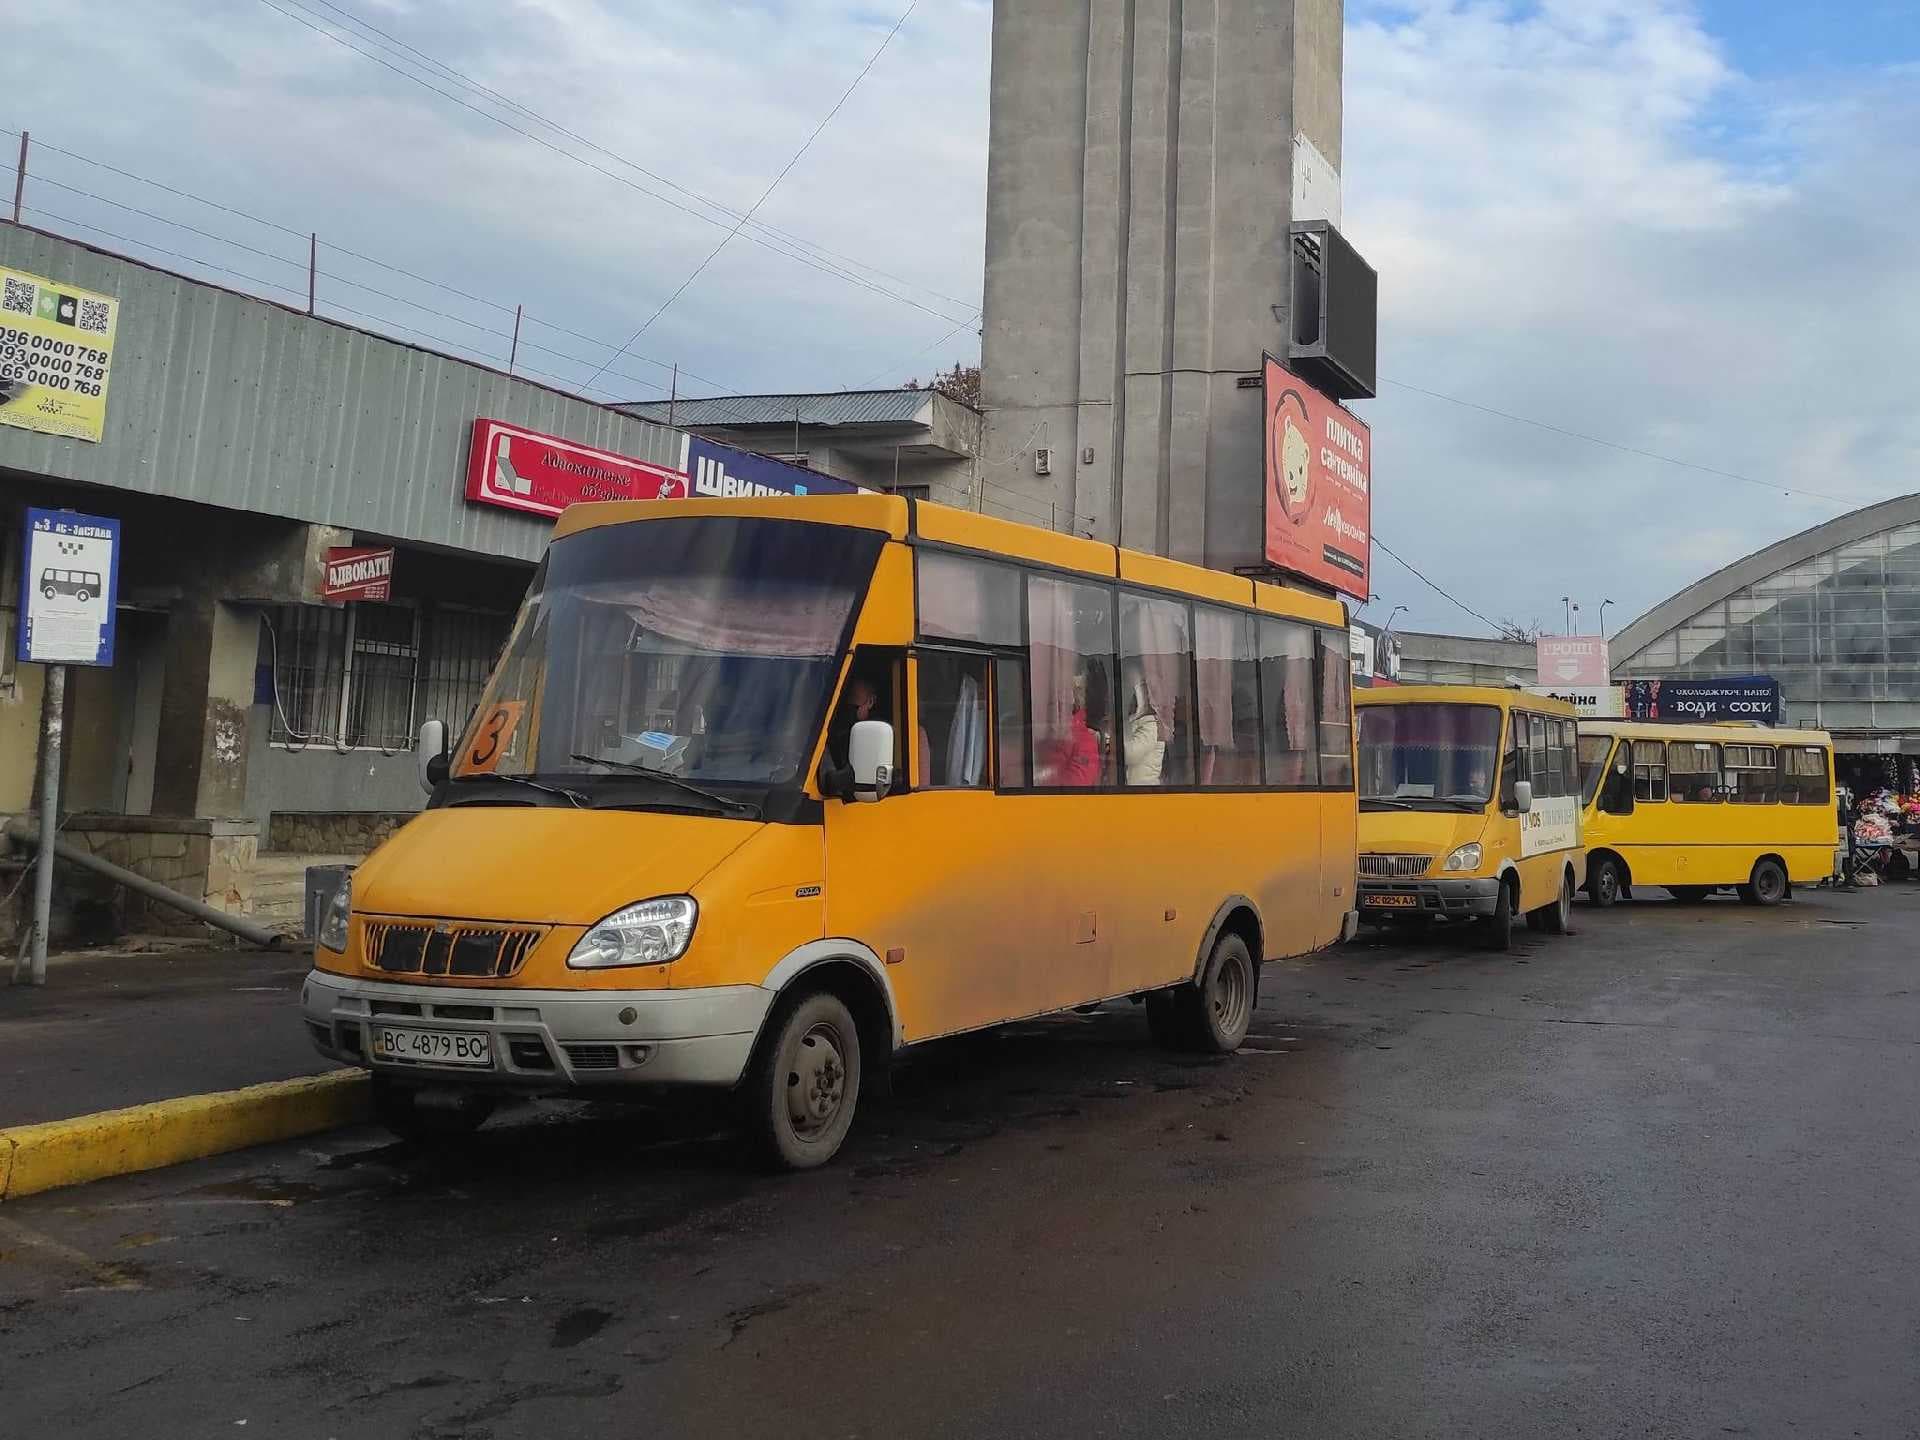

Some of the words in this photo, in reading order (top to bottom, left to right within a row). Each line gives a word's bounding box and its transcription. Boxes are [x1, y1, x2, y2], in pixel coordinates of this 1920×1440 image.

[31, 335, 74, 357] 0000
[78, 346, 108, 365] 768
[29, 352, 72, 374] 0000
[75, 362, 105, 381] 768
[27, 369, 70, 390] 0000
[74, 379, 101, 397] 768
[329, 556, 390, 587] АДВОКАТИ
[1677, 701, 1717, 717] ВОДИ
[1729, 702, 1772, 713] СОКИ
[472, 709, 508, 766] 3
[412, 1035, 451, 1056] 4879
